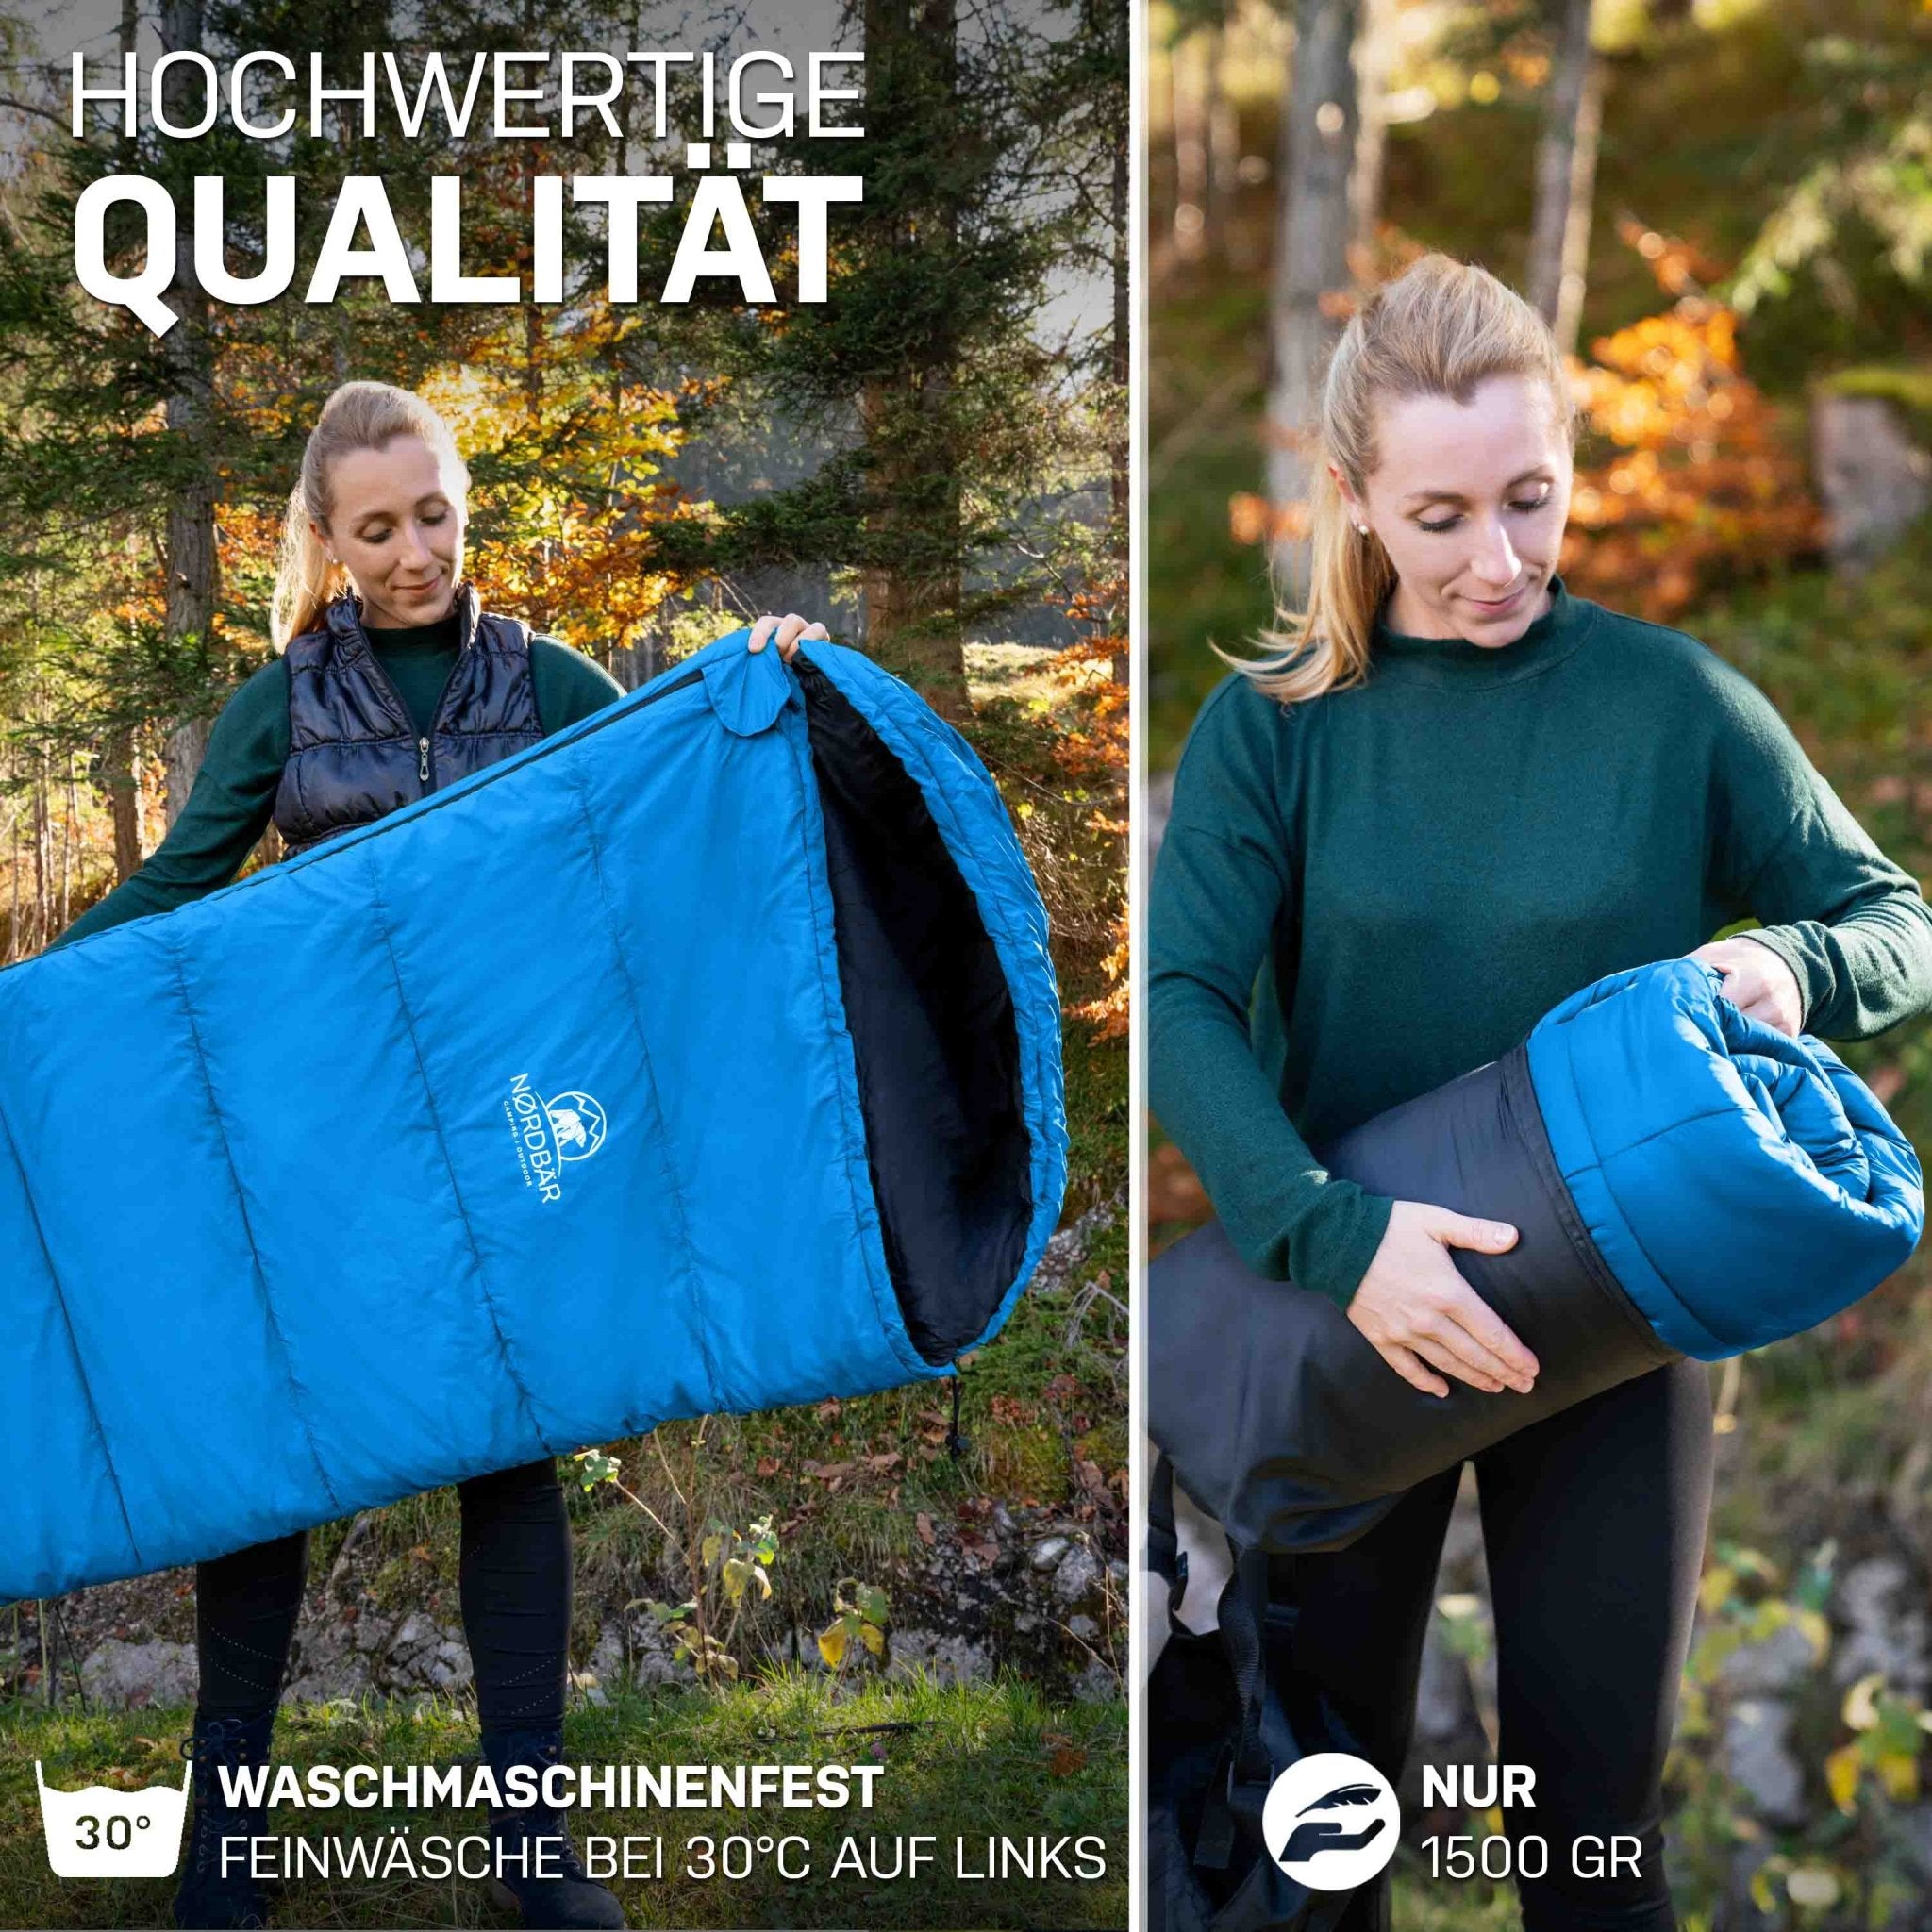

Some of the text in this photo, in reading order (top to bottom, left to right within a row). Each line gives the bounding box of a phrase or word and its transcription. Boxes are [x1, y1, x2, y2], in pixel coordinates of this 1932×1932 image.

[503, 1100, 519, 1138] CAMPING
[516, 1146, 533, 1187] OUTDOOR
[509, 1073, 561, 1203] NØRDBÄR
